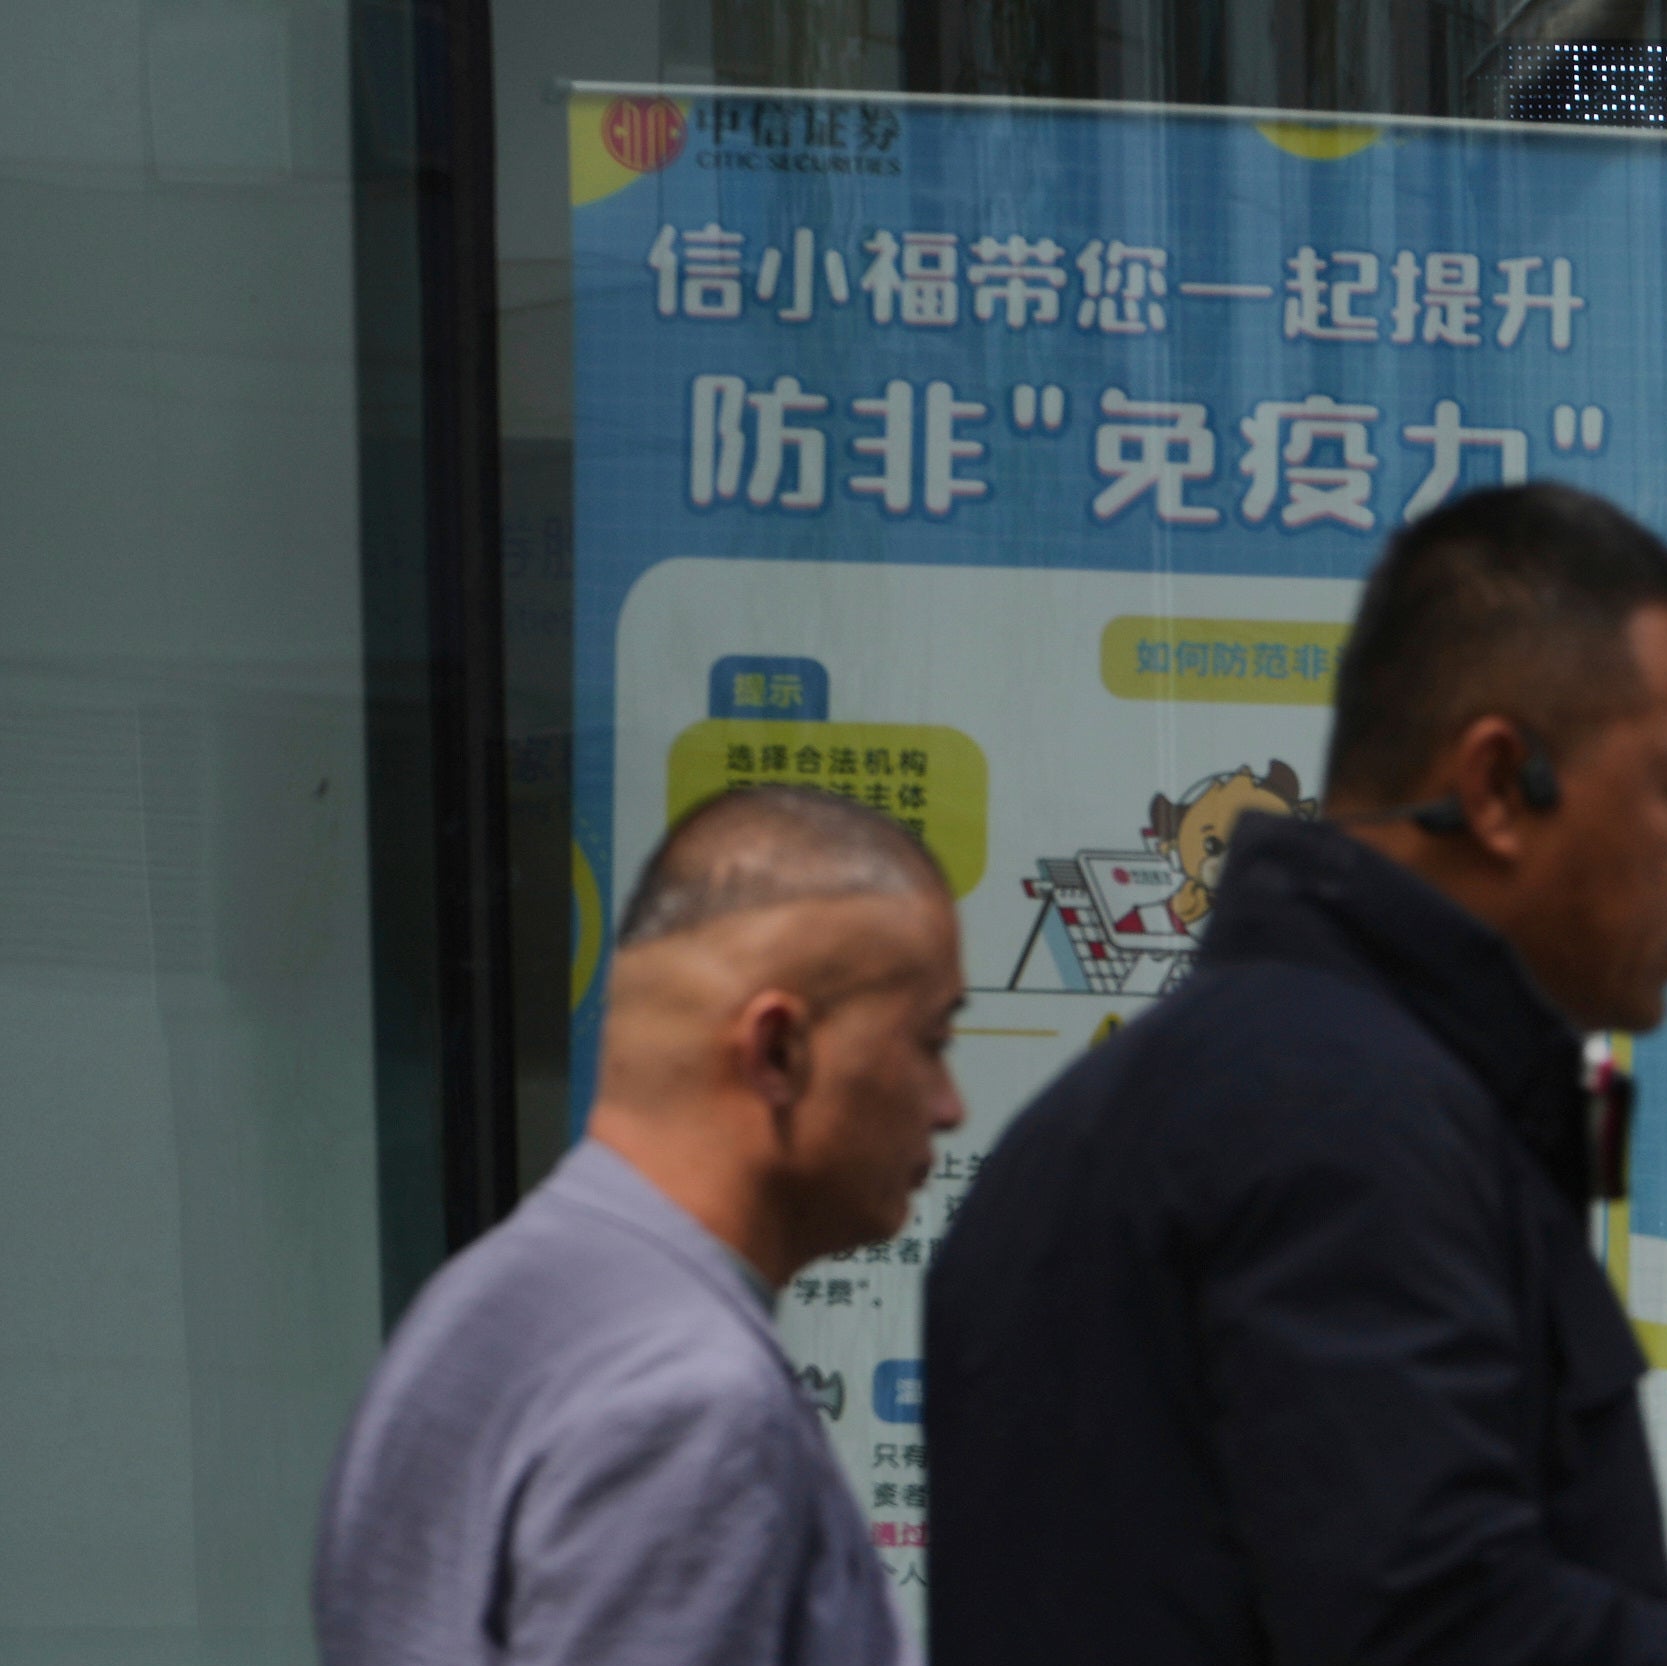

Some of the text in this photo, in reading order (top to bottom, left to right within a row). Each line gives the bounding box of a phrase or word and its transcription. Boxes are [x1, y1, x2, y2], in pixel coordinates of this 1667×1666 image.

[695, 98, 902, 152] 中信证券
[695, 149, 902, 177] CITIC SECURITIES
[648, 221, 1584, 351] 信小福带您一起提升
[1136, 638, 1336, 683] 如何防范非
[733, 672, 803, 707] 提示
[727, 743, 928, 777] 选择合法机构
[873, 1442, 928, 1470] 只有
